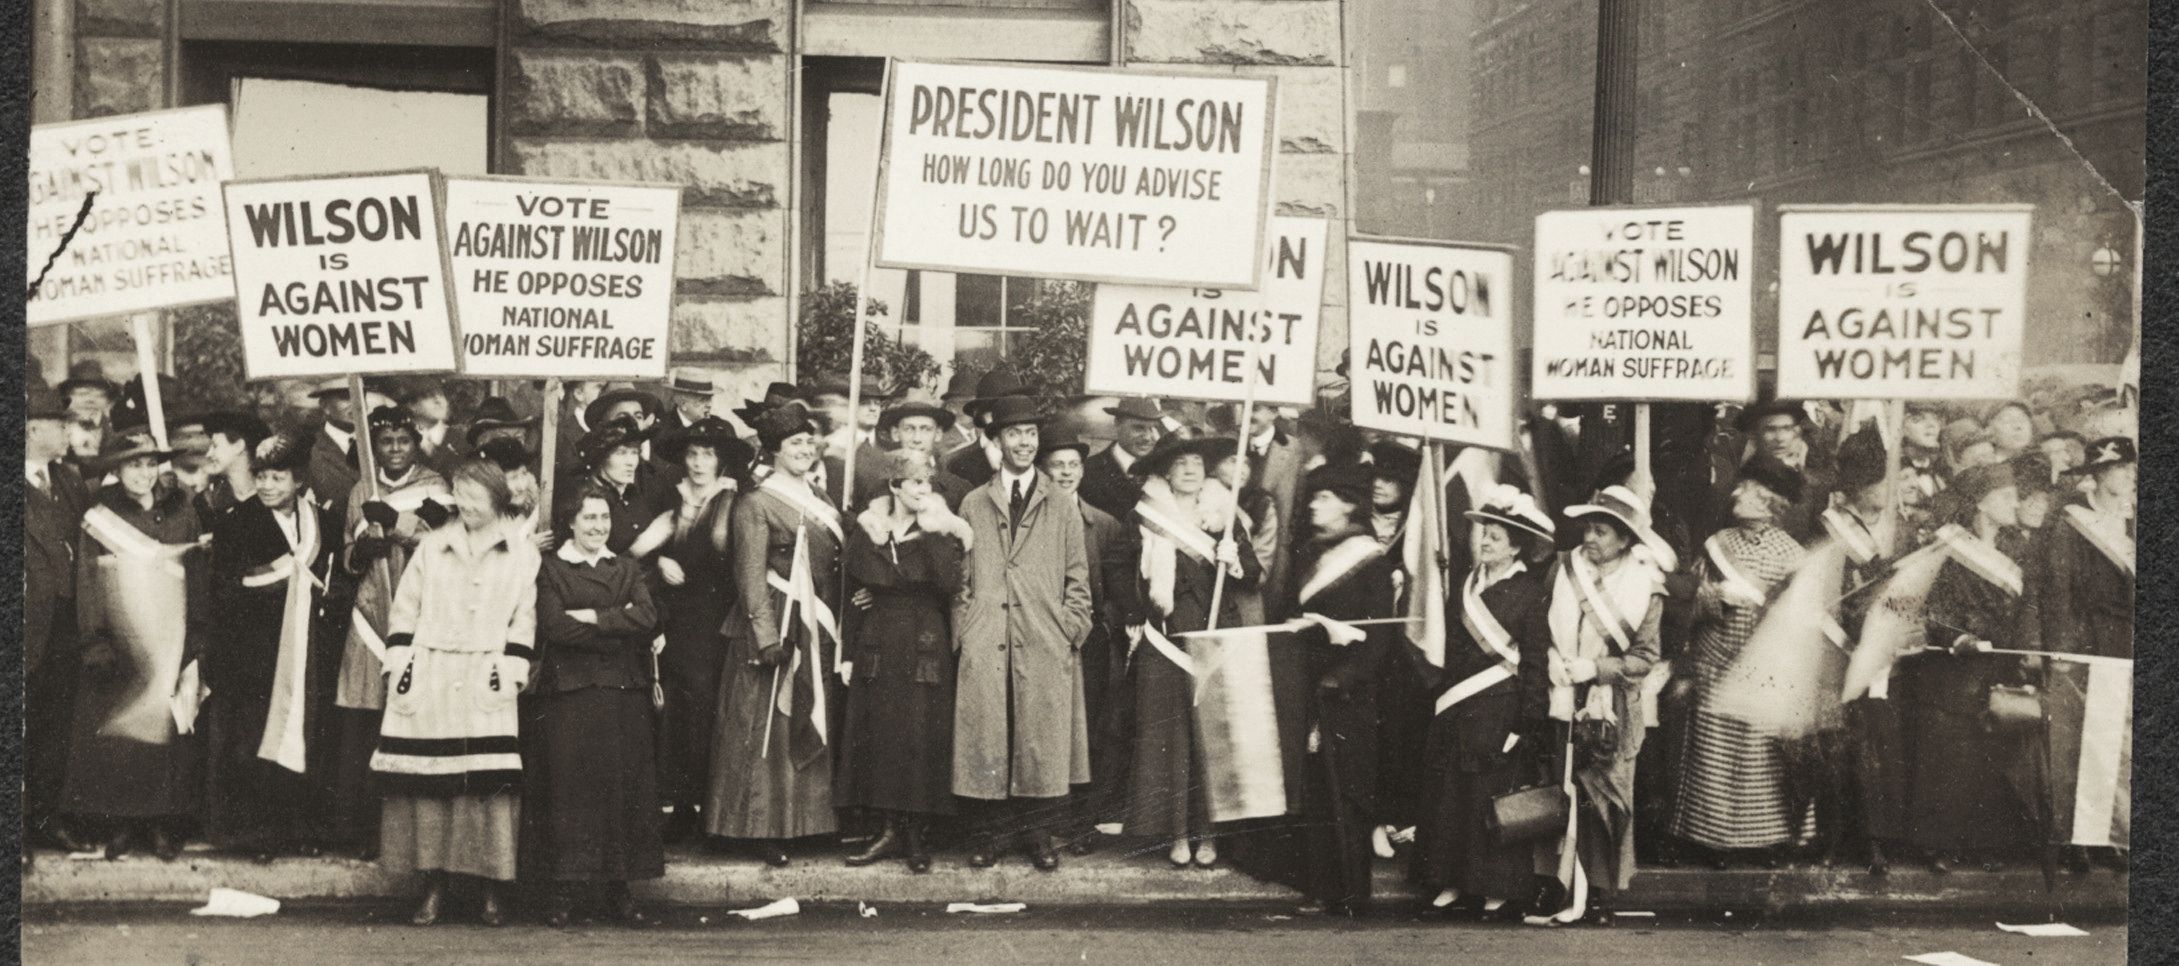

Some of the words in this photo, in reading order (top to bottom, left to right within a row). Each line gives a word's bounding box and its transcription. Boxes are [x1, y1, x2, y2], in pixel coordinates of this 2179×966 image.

[909, 84, 1101, 145] PRESIDENT
[1115, 93, 1244, 154] WILSON
[62, 127, 154, 156] VOTE
[29, 162, 116, 204] GAINST
[128, 151, 217, 188] WILSON
[922, 153, 972, 184] HOW
[978, 156, 1032, 190] LONG
[1042, 160, 1072, 192] DO
[1082, 162, 1128, 195] YOU
[1135, 166, 1223, 202] ADVISE
[35, 214, 68, 239] HE
[83, 195, 208, 234] OPPOSES
[244, 195, 422, 248] WILSON
[516, 195, 611, 221] VOTE
[453, 221, 565, 262] AGAINST
[572, 224, 663, 265] WILSON
[958, 203, 998, 240] US
[1011, 206, 1049, 244] TO
[1065, 209, 1148, 251] WAIT
[1158, 215, 1177, 253] ?
[72, 234, 187, 266] NATIONAL
[319, 252, 349, 271] IS
[1654, 248, 1739, 283] WILSON
[1805, 230, 2008, 275] WILSON
[115, 255, 232, 291] SUFFRAGE
[472, 269, 509, 294] HE
[517, 270, 643, 299] OPPOSES
[1365, 259, 1493, 318] WILSON
[1886, 282, 1917, 298] IS
[259, 275, 429, 317] AGAINST
[1604, 294, 1722, 318] OPPOSES
[502, 305, 614, 330] NATIONAL
[1114, 303, 1303, 345] AGAINST
[1416, 319, 1438, 336] IS
[1803, 307, 2002, 340] AGAINST
[271, 320, 417, 359] WOMEN
[536, 334, 655, 360] SUFFRAGE
[1590, 329, 1694, 351] NATIONAL
[1124, 344, 1276, 386] WOMEN
[1366, 338, 1496, 387] AGAINST
[1547, 357, 1615, 378] WOMAN
[1622, 356, 1735, 380] SUFFRAGE
[1815, 347, 1976, 380] WOMEN
[1373, 380, 1479, 429] WOMEN
